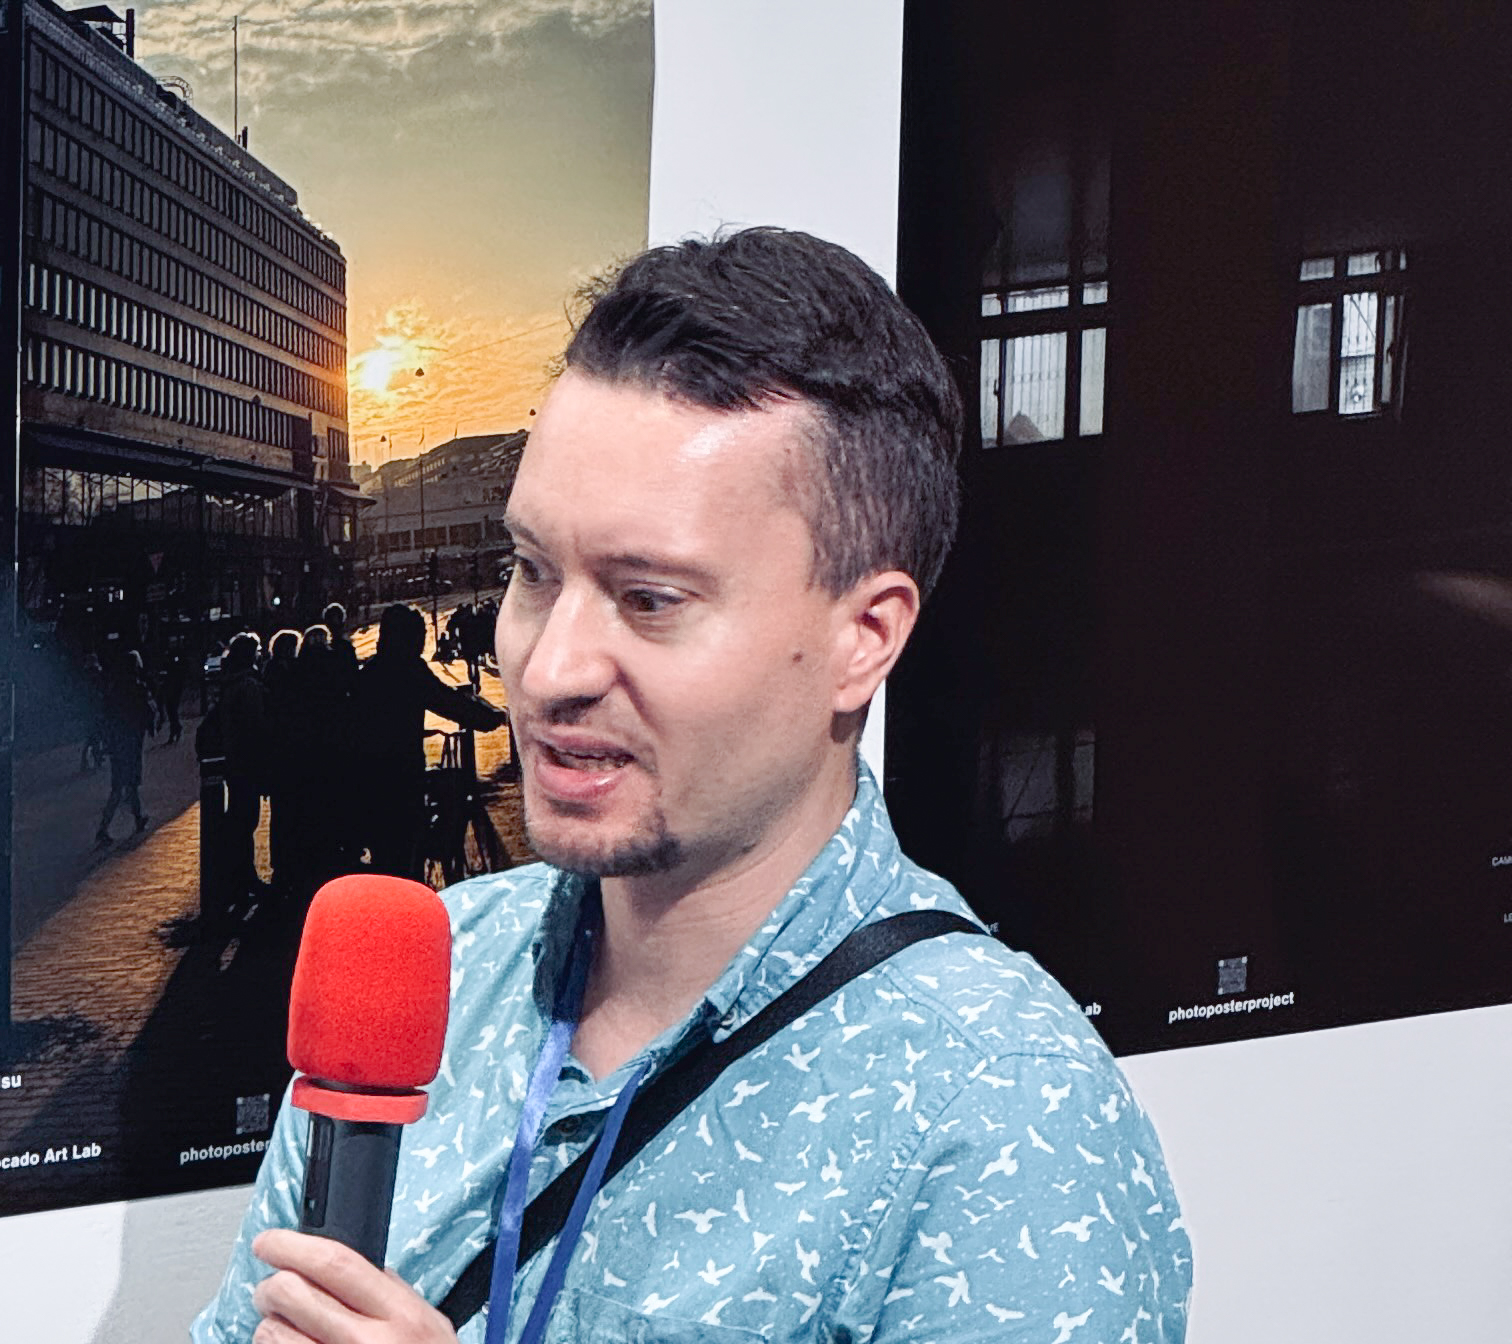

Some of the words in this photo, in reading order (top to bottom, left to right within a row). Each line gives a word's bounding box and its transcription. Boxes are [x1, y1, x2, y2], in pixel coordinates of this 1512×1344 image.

[1084, 1002, 1102, 1016] ab
[1168, 991, 1295, 1024] photoposterproject
[44, 1147, 68, 1164] Art
[72, 1142, 102, 1159] Lab
